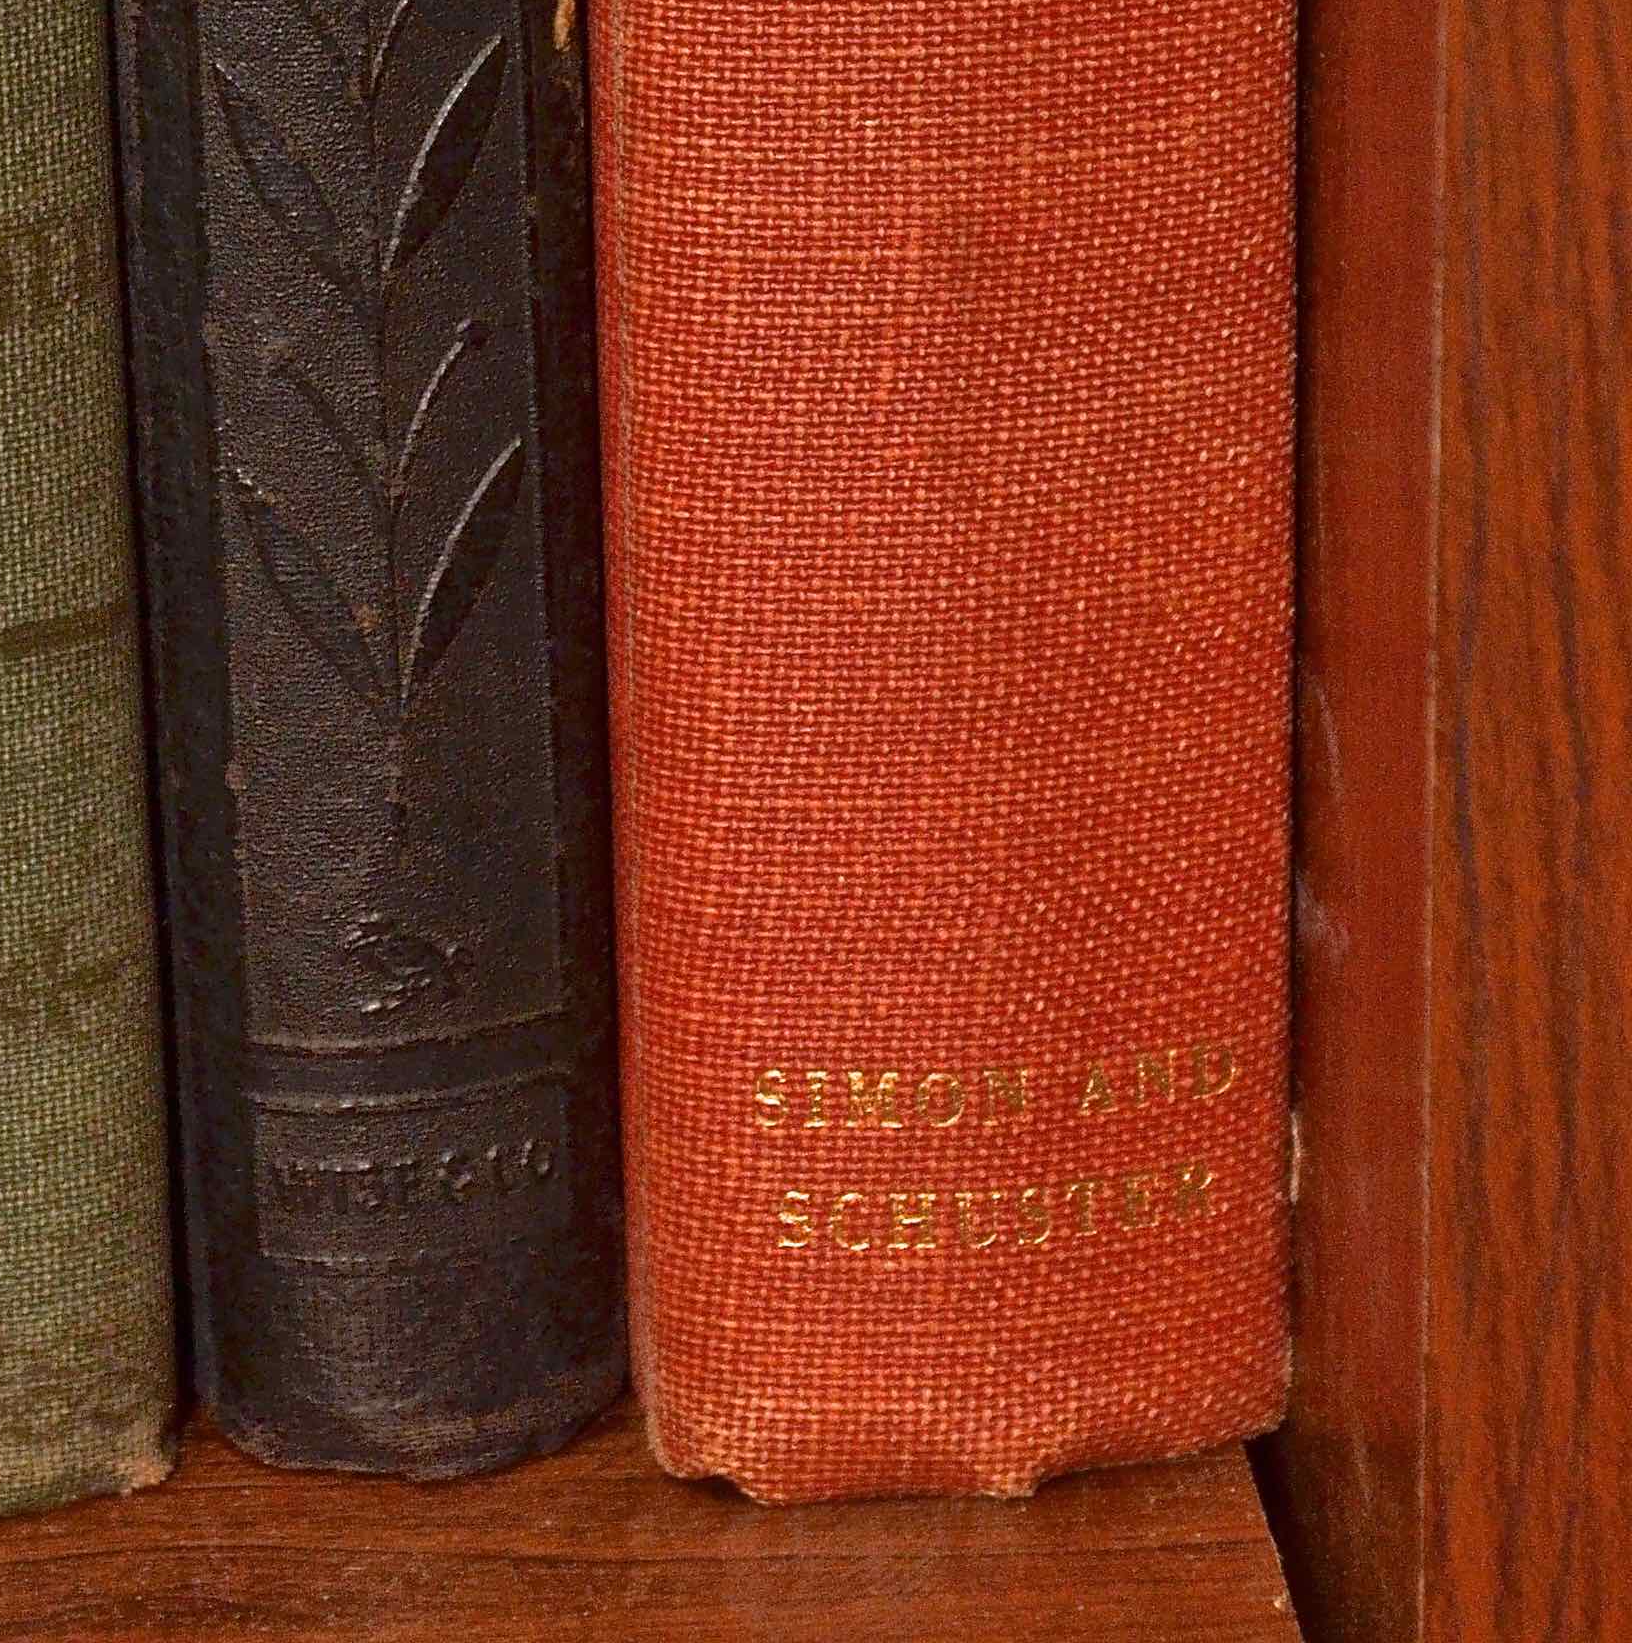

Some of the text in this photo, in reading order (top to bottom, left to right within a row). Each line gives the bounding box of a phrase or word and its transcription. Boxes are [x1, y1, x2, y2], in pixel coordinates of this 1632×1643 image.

[753, 1041, 1240, 1130] SIMON AND
[776, 1158, 1216, 1251] SCHUSTER
